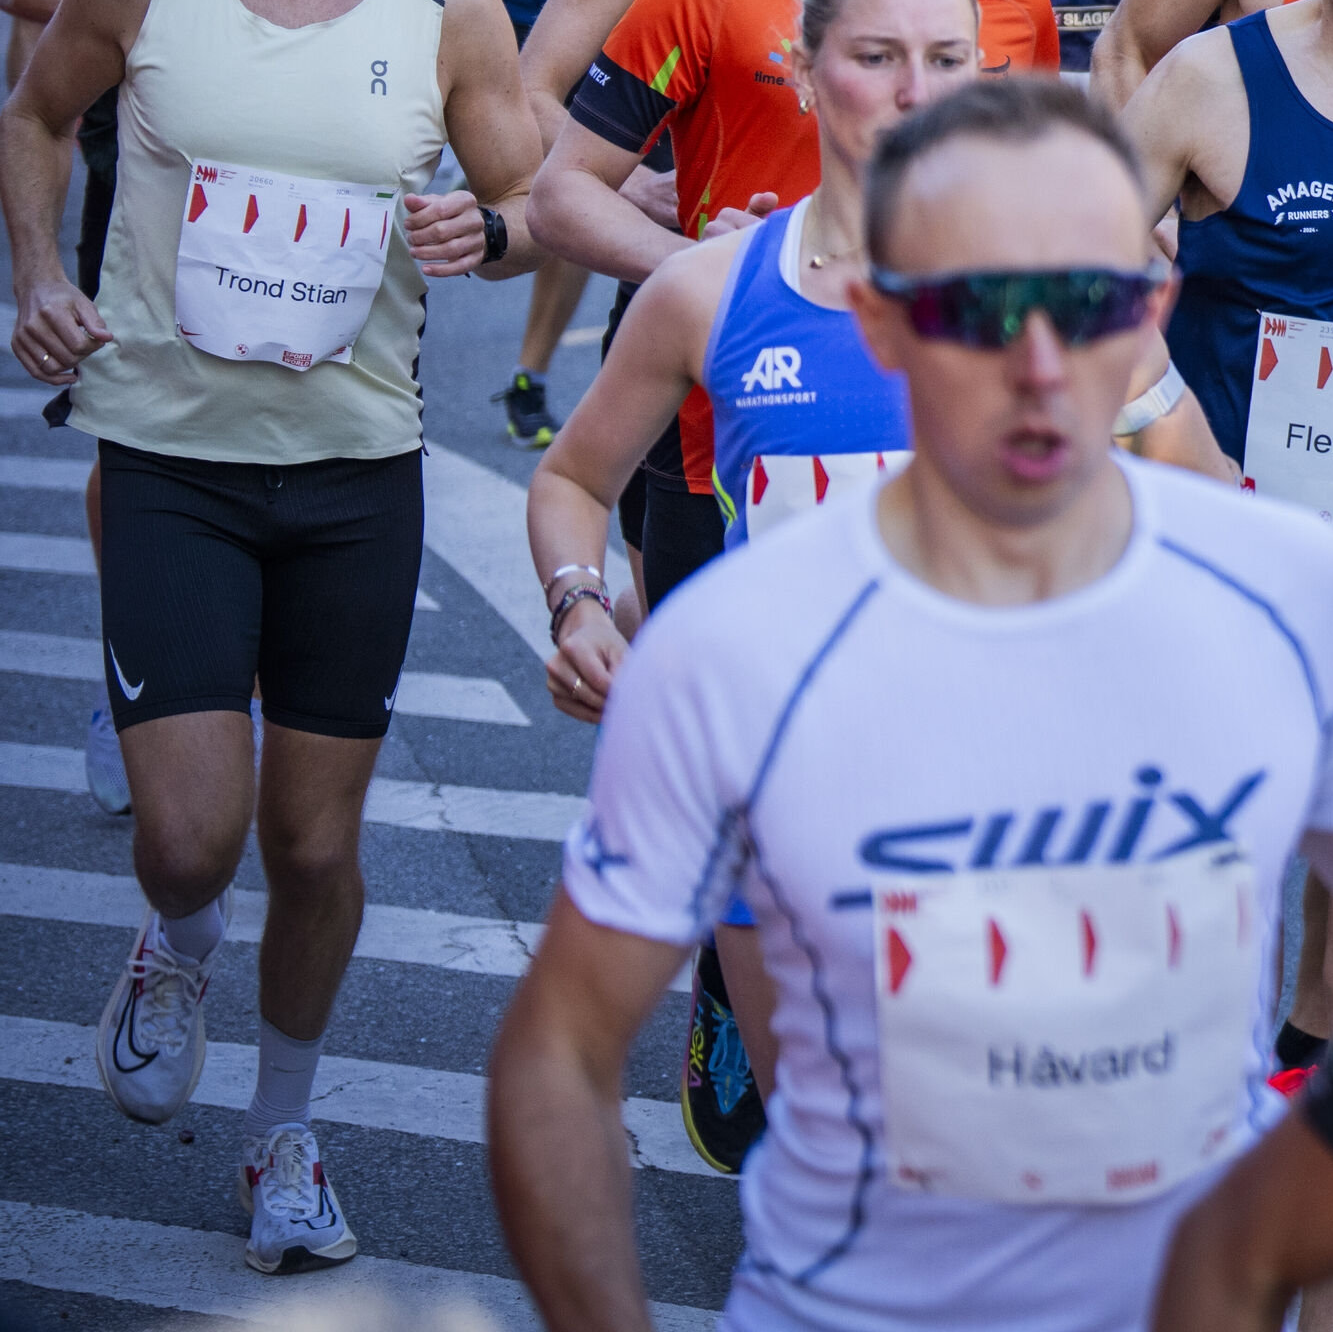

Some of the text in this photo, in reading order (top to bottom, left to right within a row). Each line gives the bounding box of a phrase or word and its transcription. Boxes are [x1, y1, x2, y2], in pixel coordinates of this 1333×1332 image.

[1287, 210, 1330, 221] RUNNERS
[215, 265, 348, 305] Trond Stian
[283, 358, 311, 367] WORLD
[285, 351, 312, 361] SPORTS
[735, 391, 817, 408] MARATHONSPORT
[986, 1029, 1178, 1090] Håvard
